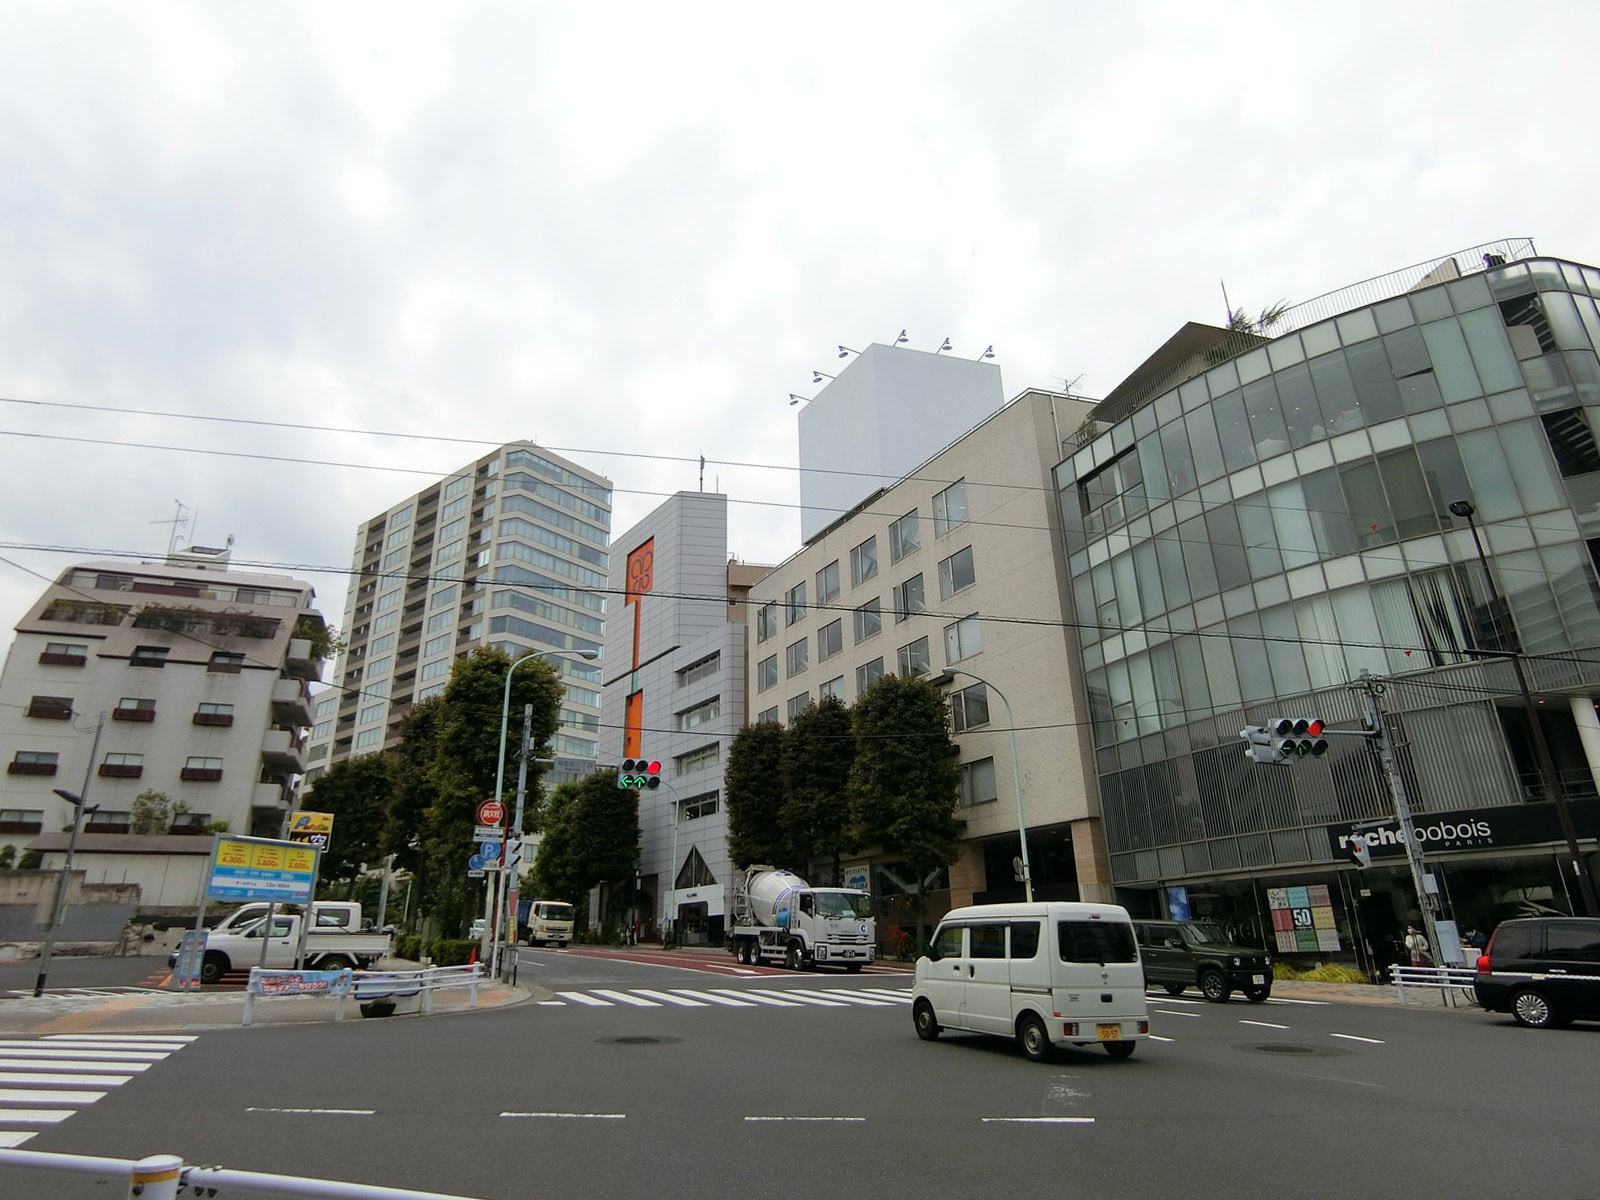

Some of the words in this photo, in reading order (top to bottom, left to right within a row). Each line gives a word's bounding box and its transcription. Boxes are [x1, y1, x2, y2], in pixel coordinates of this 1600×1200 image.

[1445, 838, 1493, 847] PARIS
[485, 844, 494, 858] P
[1292, 908, 1312, 926] 50
